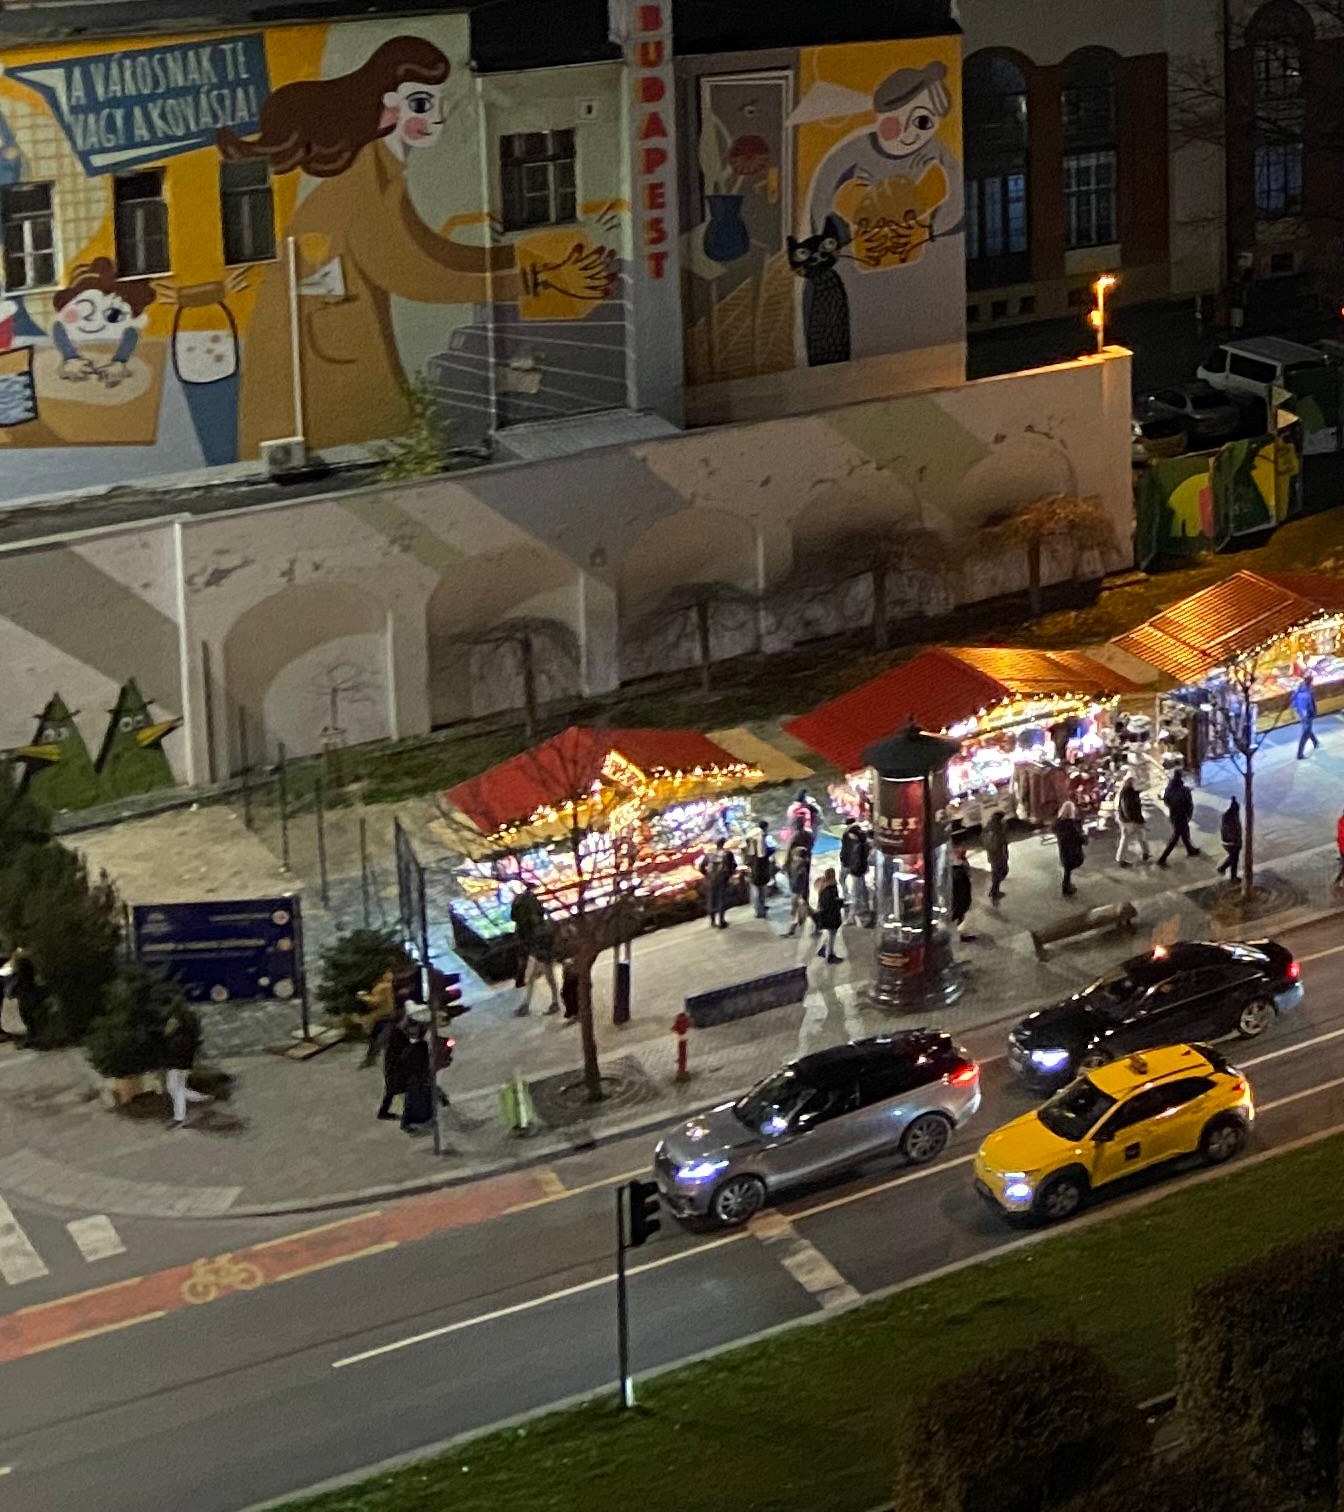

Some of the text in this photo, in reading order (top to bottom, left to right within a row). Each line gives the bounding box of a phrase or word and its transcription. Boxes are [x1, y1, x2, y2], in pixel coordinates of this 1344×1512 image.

[71, 41, 250, 106] A VÁROSNAK TE
[132, 105, 150, 142] A
[635, 4, 668, 279] BUDAPEST
